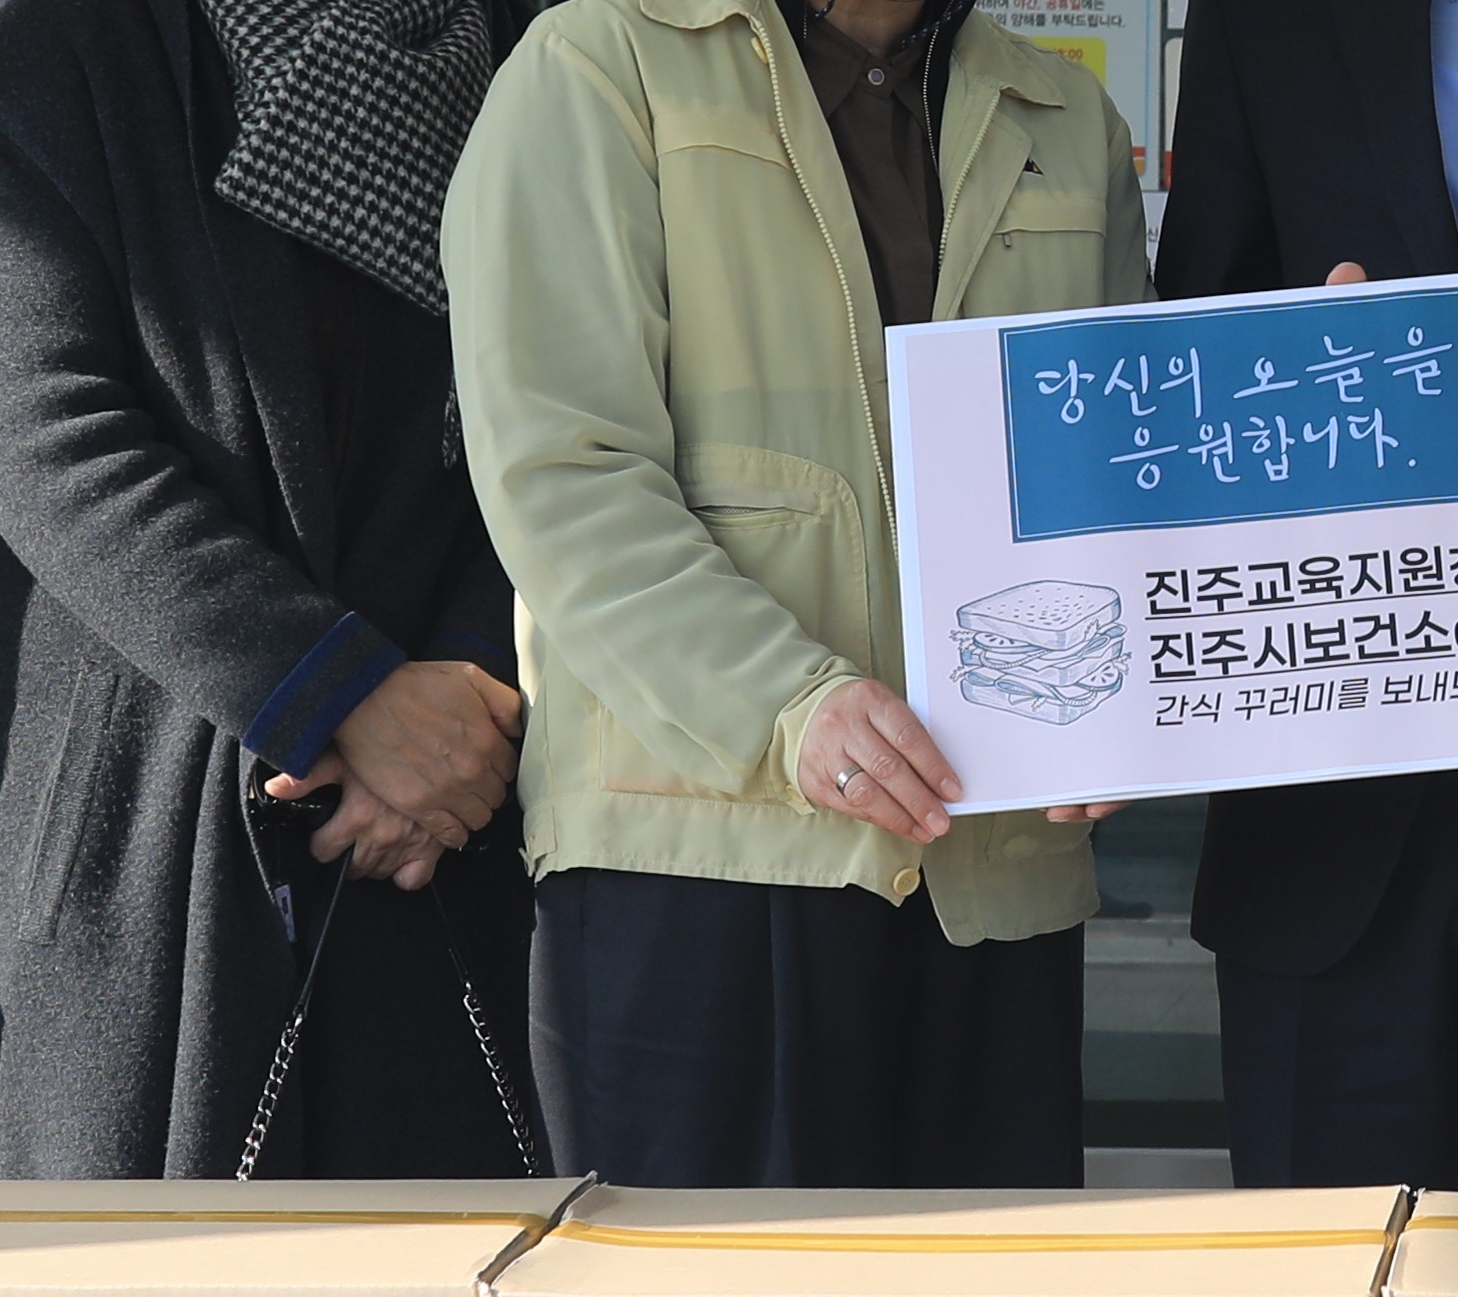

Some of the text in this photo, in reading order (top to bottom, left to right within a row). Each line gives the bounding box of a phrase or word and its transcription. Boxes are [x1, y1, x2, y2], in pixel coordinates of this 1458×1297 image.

[1034, 326, 1453, 425] 당신의 오늘을
[1109, 407, 1418, 491] 응원합니다.
[1154, 691, 1225, 729] 간식
[1233, 675, 1371, 723] 꾸러미를
